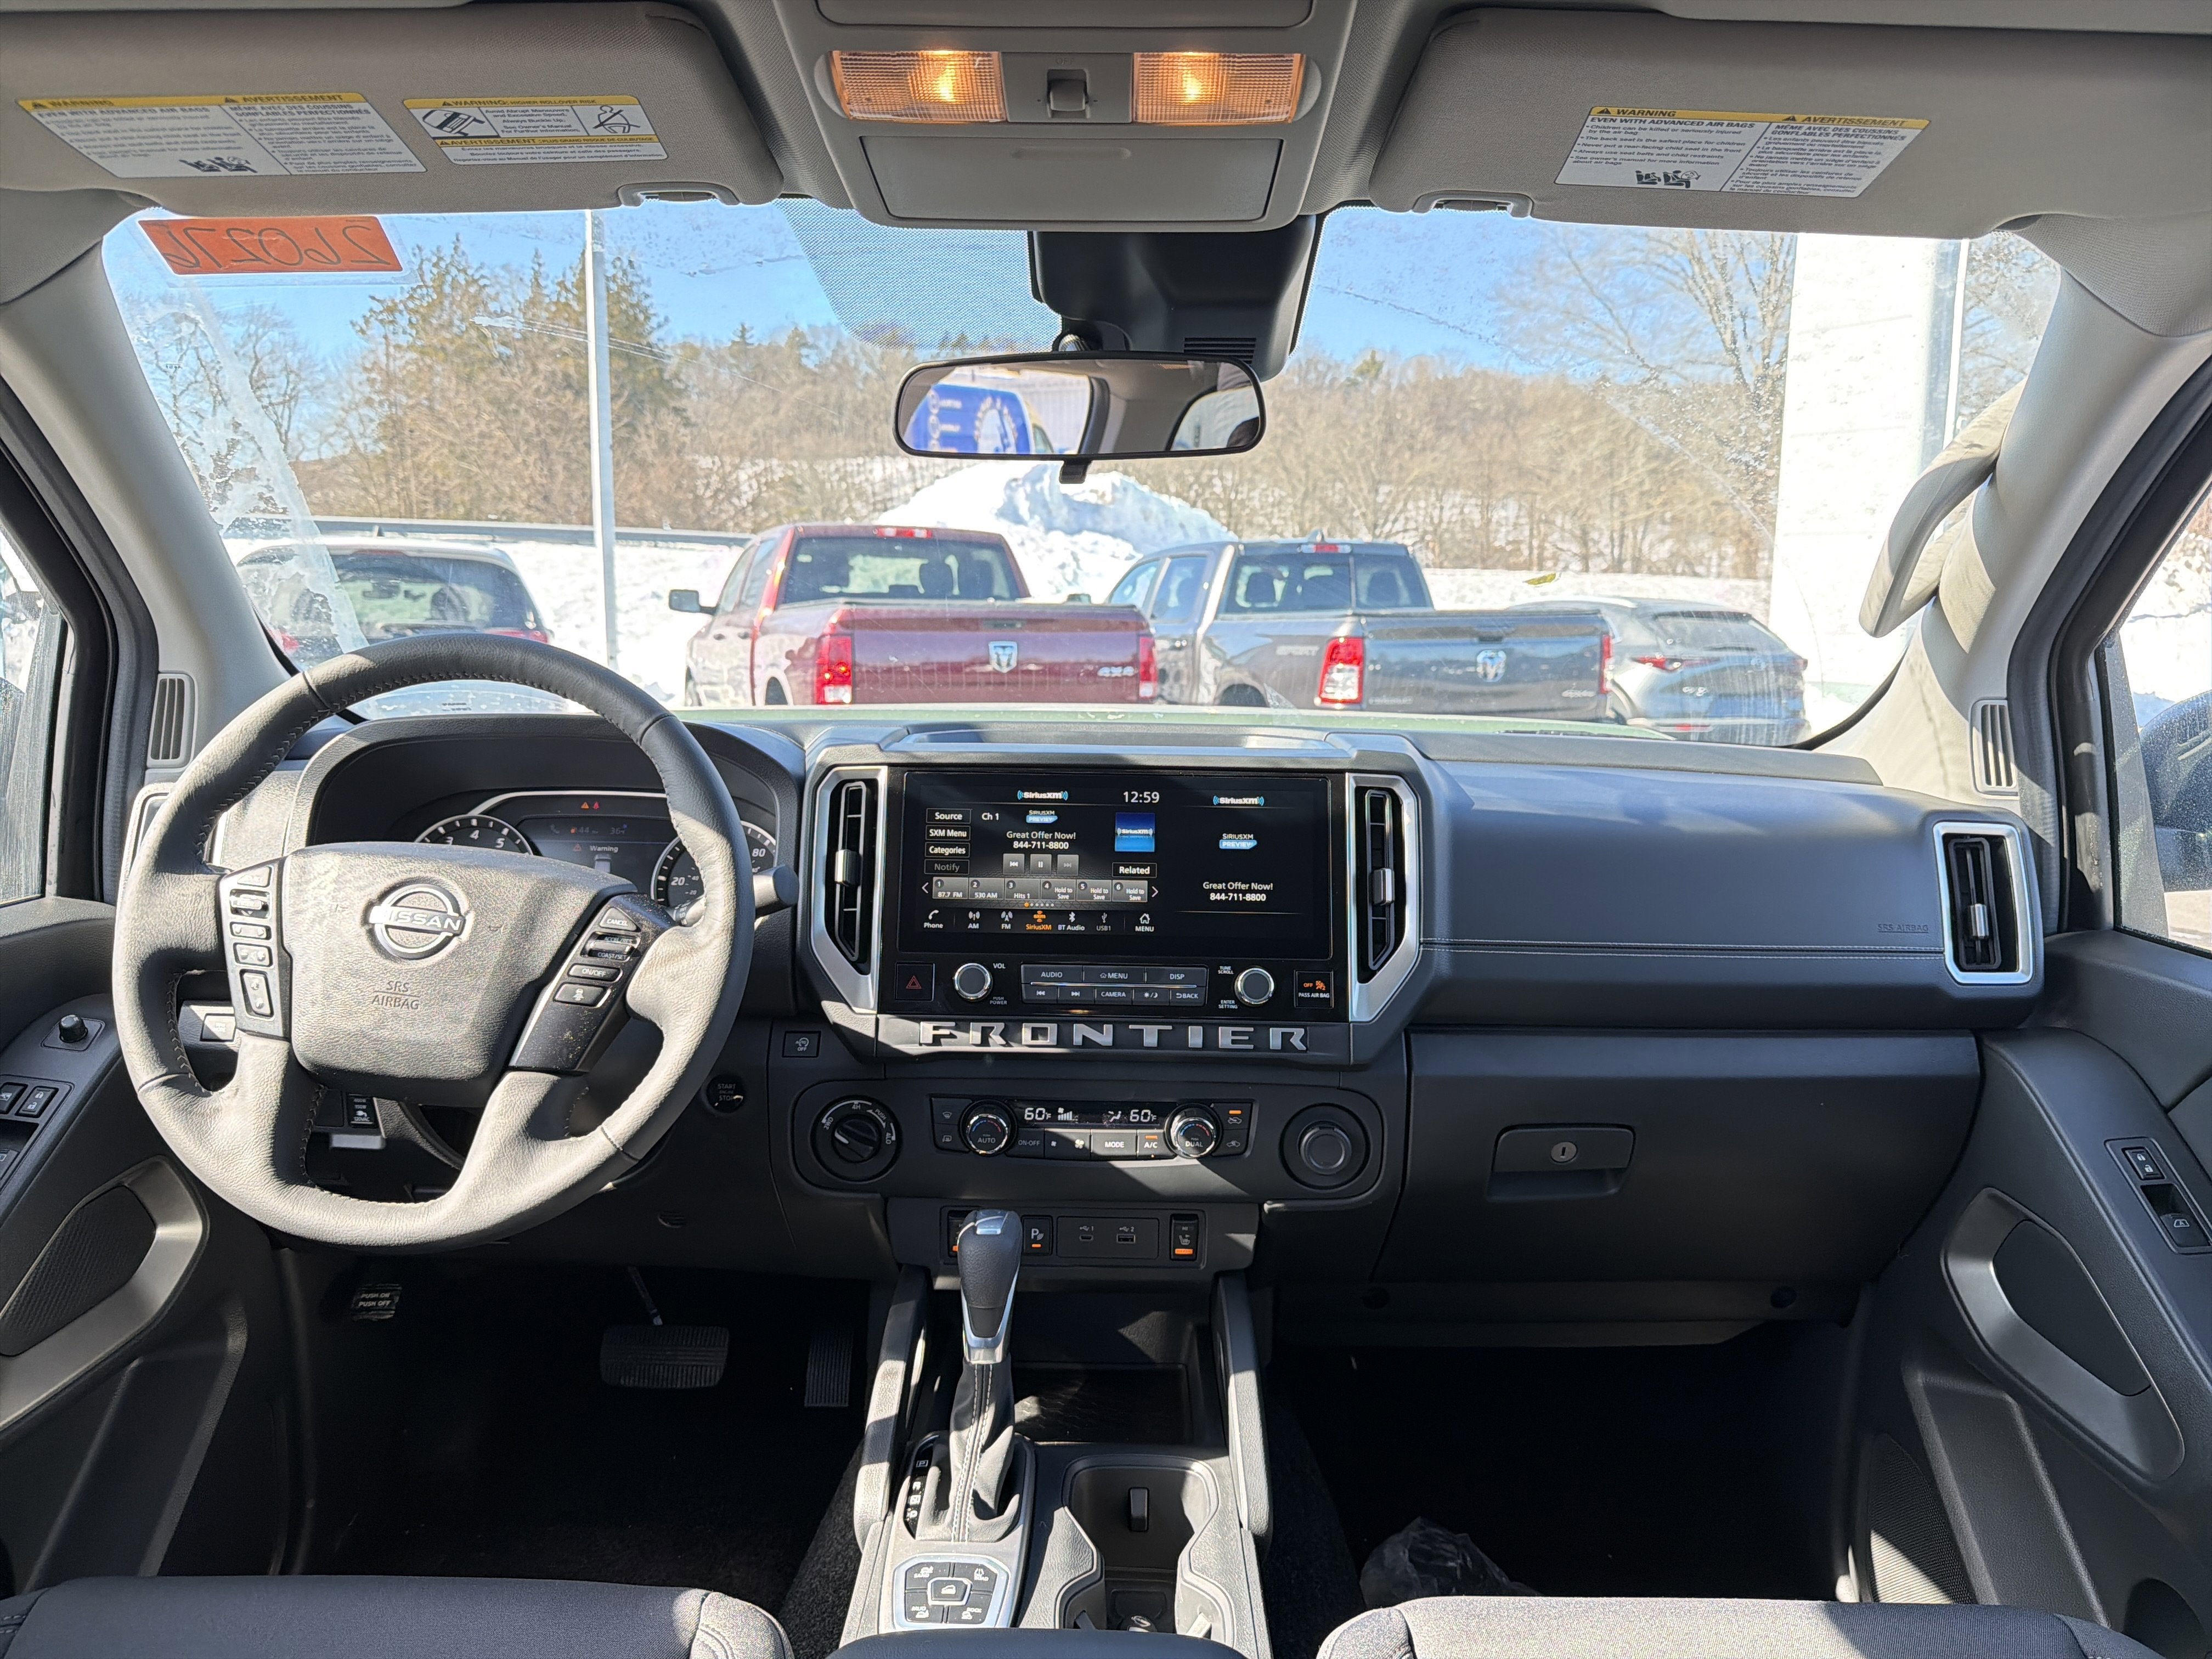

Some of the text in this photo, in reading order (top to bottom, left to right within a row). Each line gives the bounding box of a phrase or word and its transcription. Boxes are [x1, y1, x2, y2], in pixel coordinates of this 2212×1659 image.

[1616, 109, 1677, 117] WARNING
[1801, 116, 1908, 127] AVERTISSEMENT
[1123, 791, 1160, 804] 12:59
[935, 812, 963, 820] Source
[981, 812, 994, 821] Ch
[470, 830, 479, 839] 4
[929, 829, 947, 837] SXM
[445, 836, 454, 845] 3
[495, 838, 505, 848] 5
[1013, 841, 1069, 849] 844-711-8800
[752, 848, 765, 857] 80
[929, 846, 966, 854] Categories
[934, 862, 960, 872] Notify
[1119, 866, 1150, 874] Related
[671, 877, 685, 886] 20
[1203, 882, 1226, 890] Great
[1251, 882, 1273, 890] Now!
[1210, 893, 1266, 901] 844-711-8800
[374, 910, 461, 930] ISSAN
[386, 980, 410, 992] SRS
[372, 995, 420, 1009] AIRBAG
[919, 1022, 1308, 1052] FRONTIER
[875, 1109, 887, 1120] PUSH
[823, 1117, 833, 1130] 2WD
